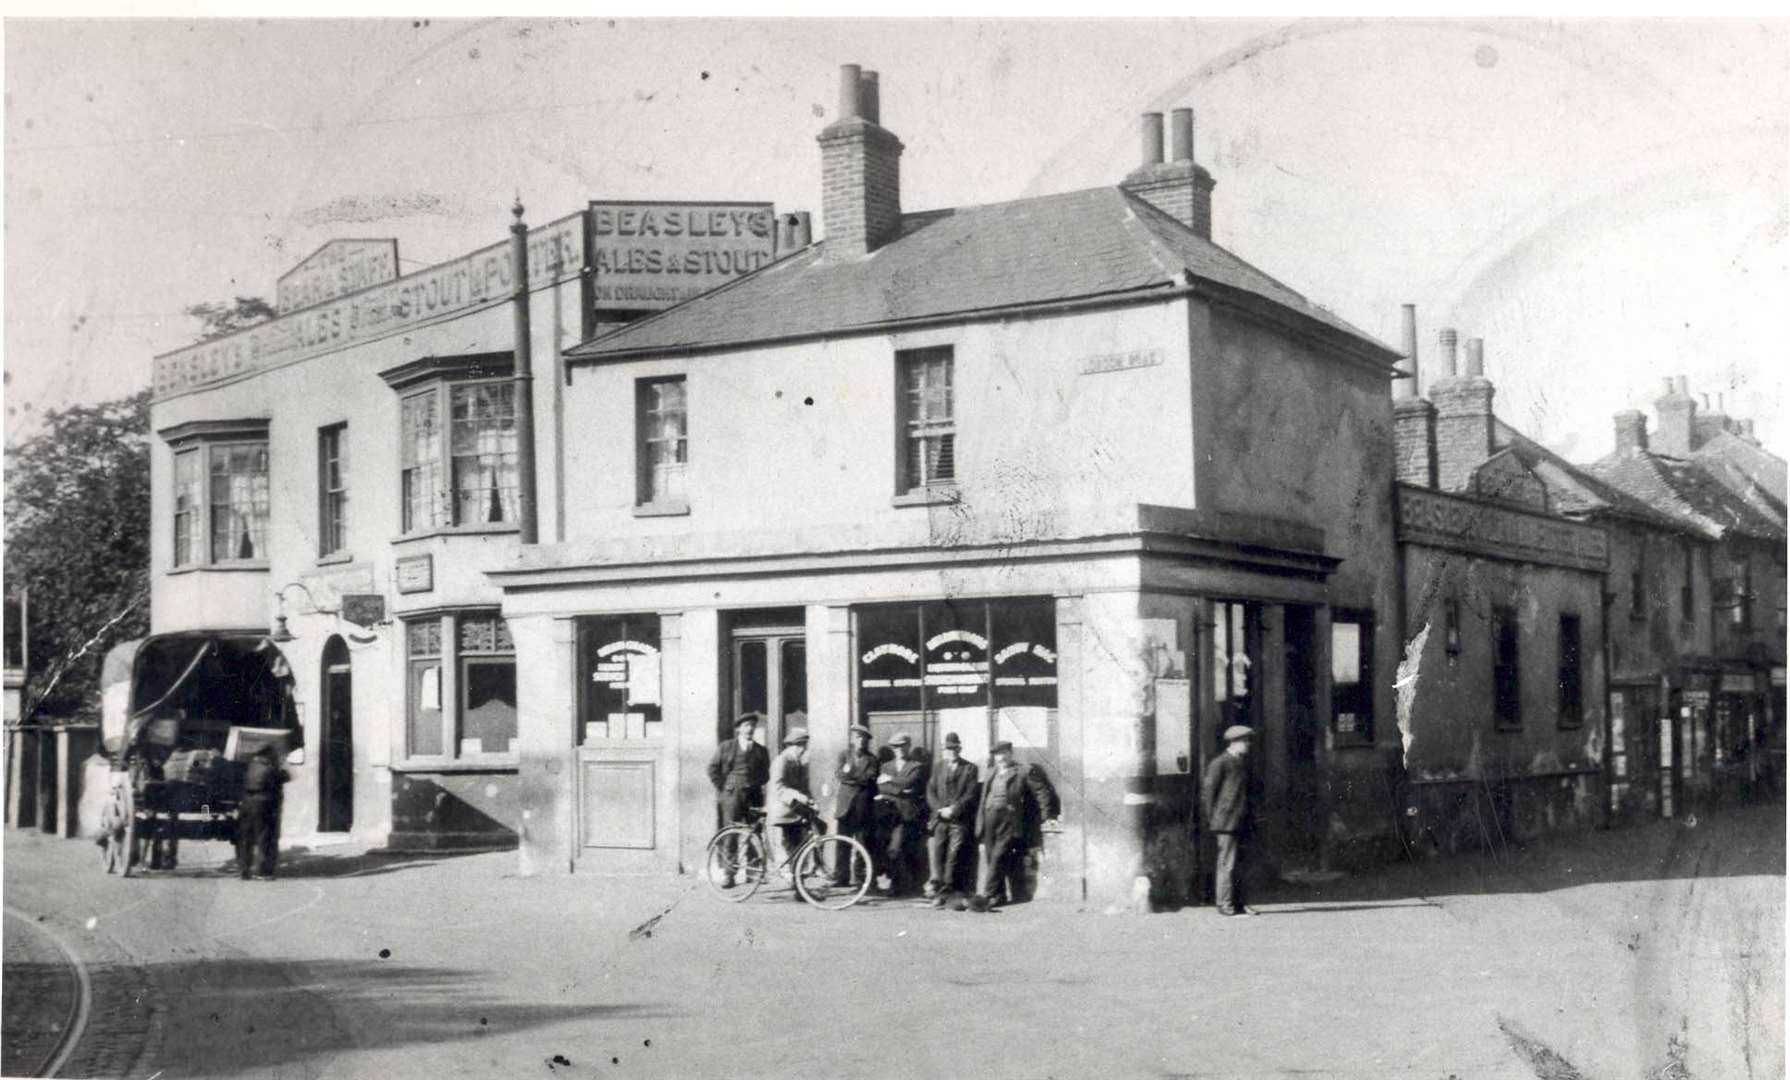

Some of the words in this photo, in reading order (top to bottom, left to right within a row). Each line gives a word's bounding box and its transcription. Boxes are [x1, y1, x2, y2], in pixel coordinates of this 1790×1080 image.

[596, 248, 663, 275] ALES
[665, 253, 682, 275] &
[684, 248, 770, 275] STOUT
[398, 269, 466, 319] STOUT
